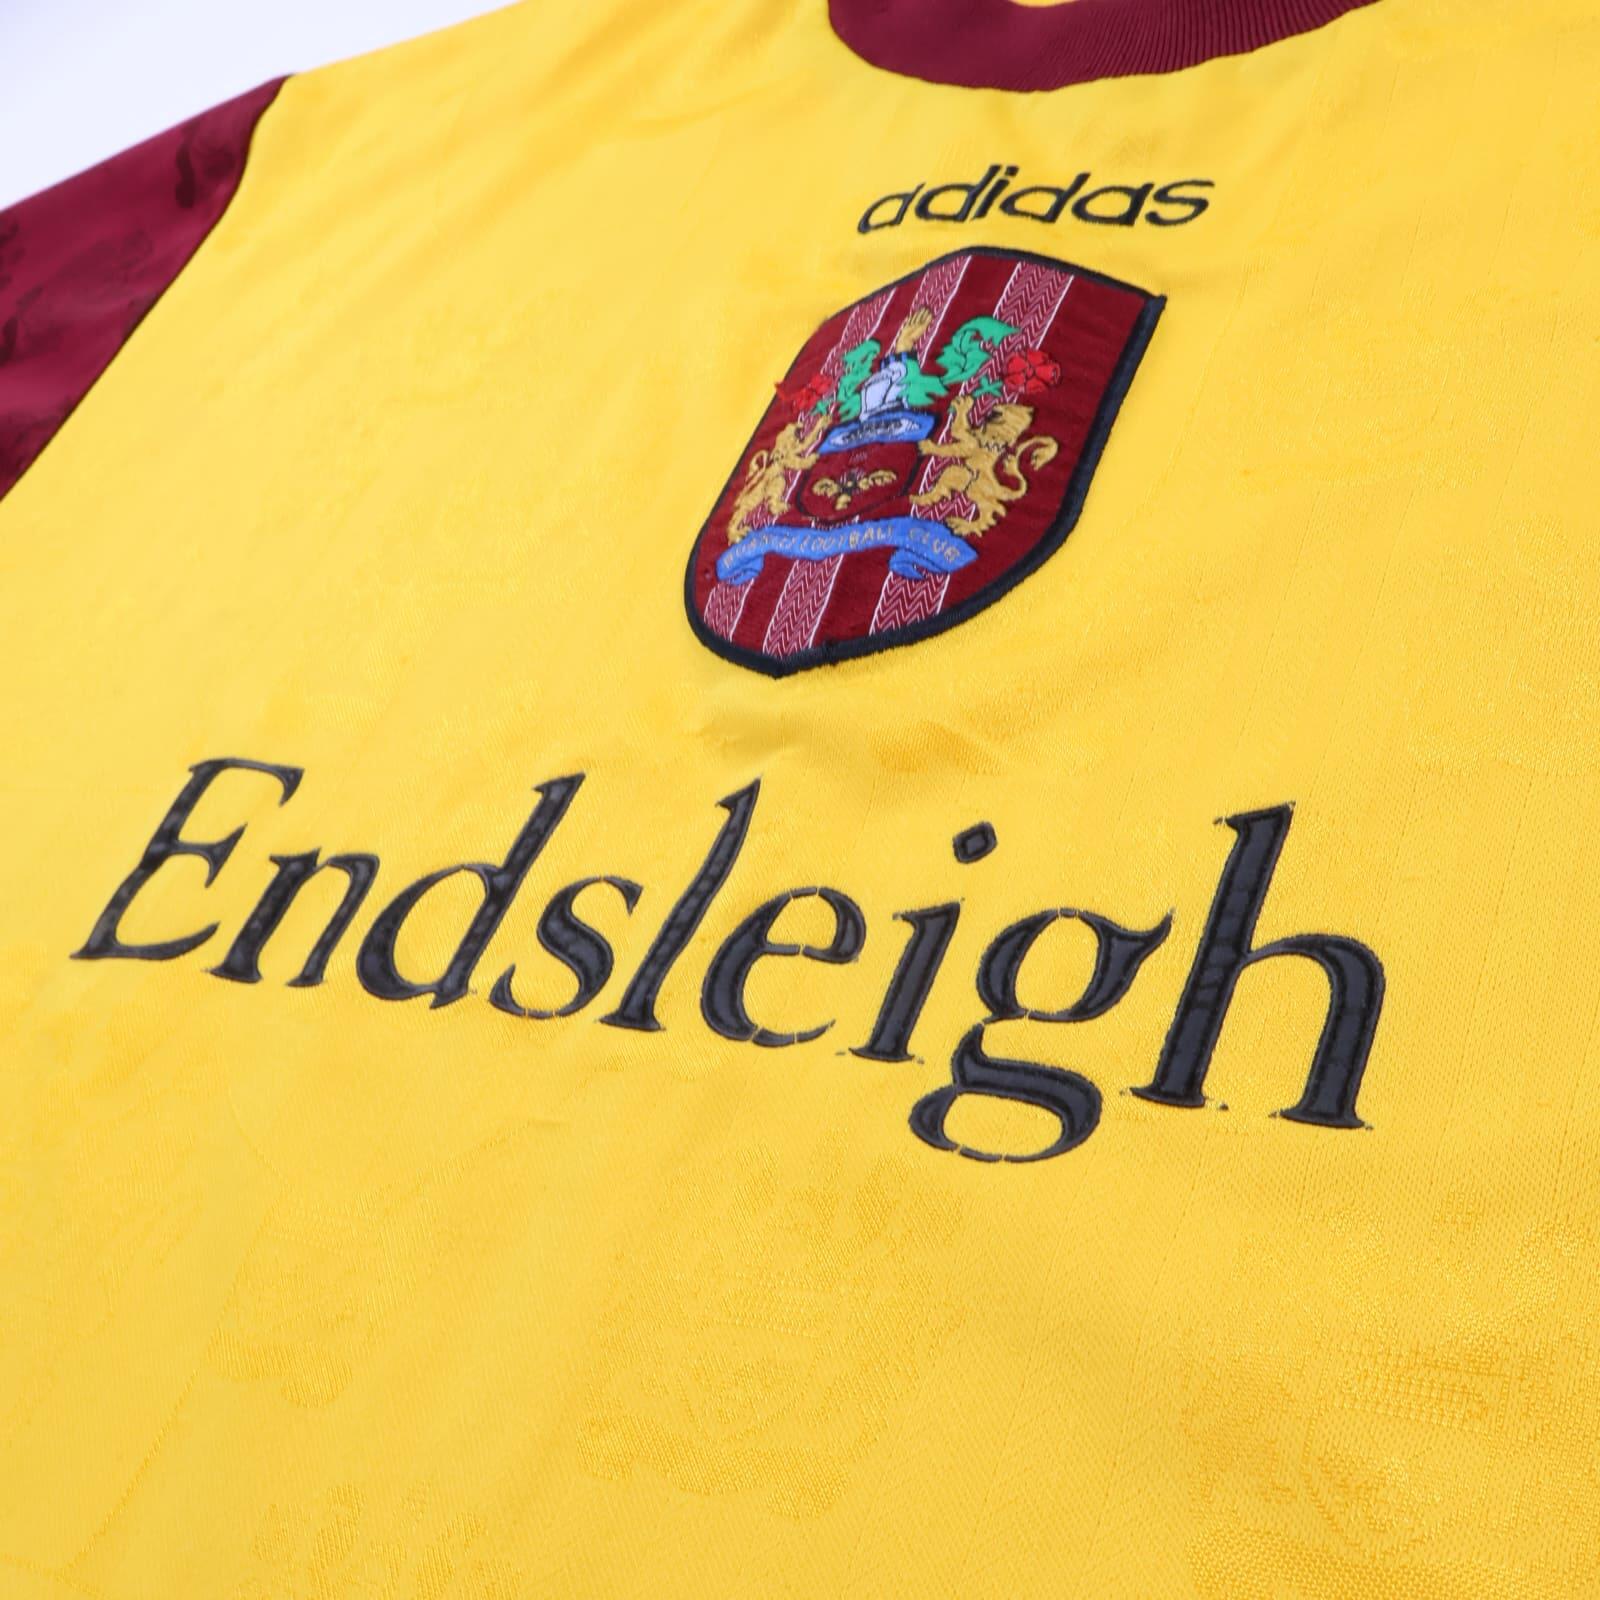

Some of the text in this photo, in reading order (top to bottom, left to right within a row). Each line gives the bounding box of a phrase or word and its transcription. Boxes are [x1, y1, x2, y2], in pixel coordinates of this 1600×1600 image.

[857, 164, 1215, 233] adidas
[908, 527, 960, 562] CLUB
[70, 756, 1386, 1164] Endsleigh
